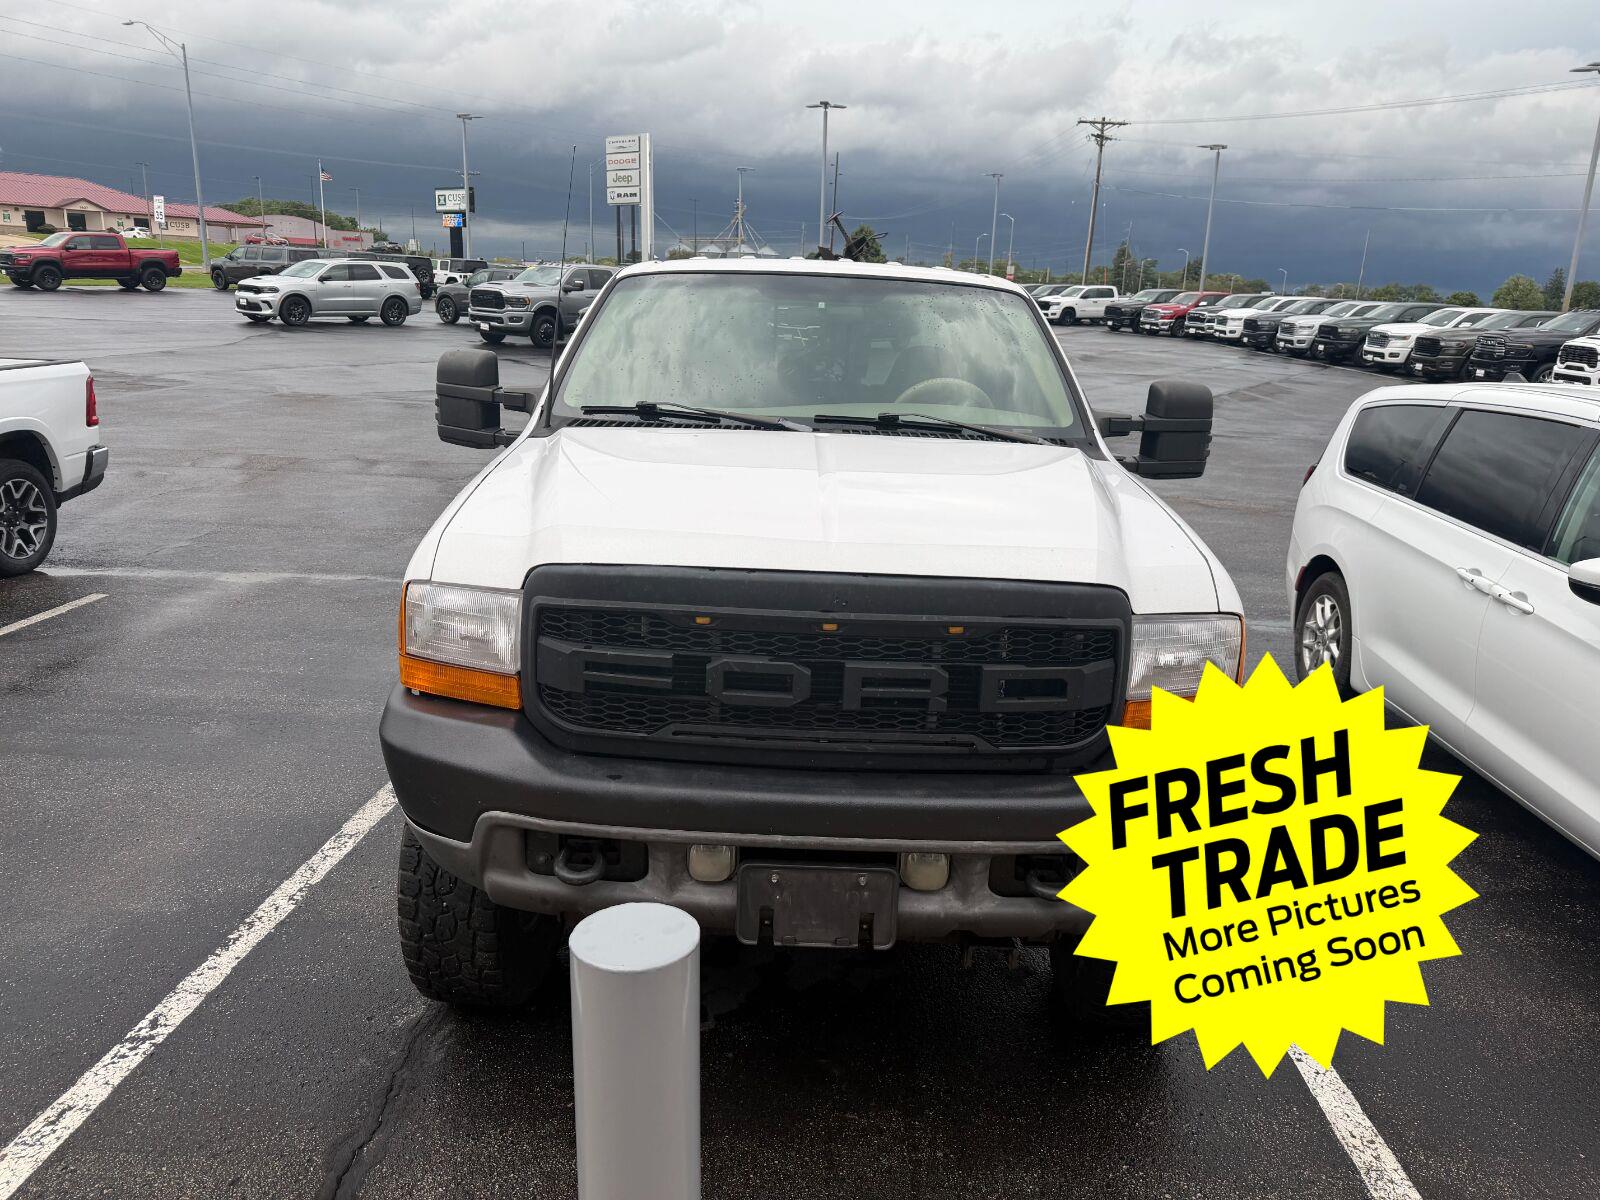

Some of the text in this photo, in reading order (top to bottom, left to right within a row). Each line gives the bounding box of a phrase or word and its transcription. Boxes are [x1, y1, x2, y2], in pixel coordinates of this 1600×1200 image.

[612, 173, 633, 184] Jeep
[155, 210, 164, 219] 35
[169, 221, 189, 229] CUSB
[537, 637, 1115, 713] FORD
